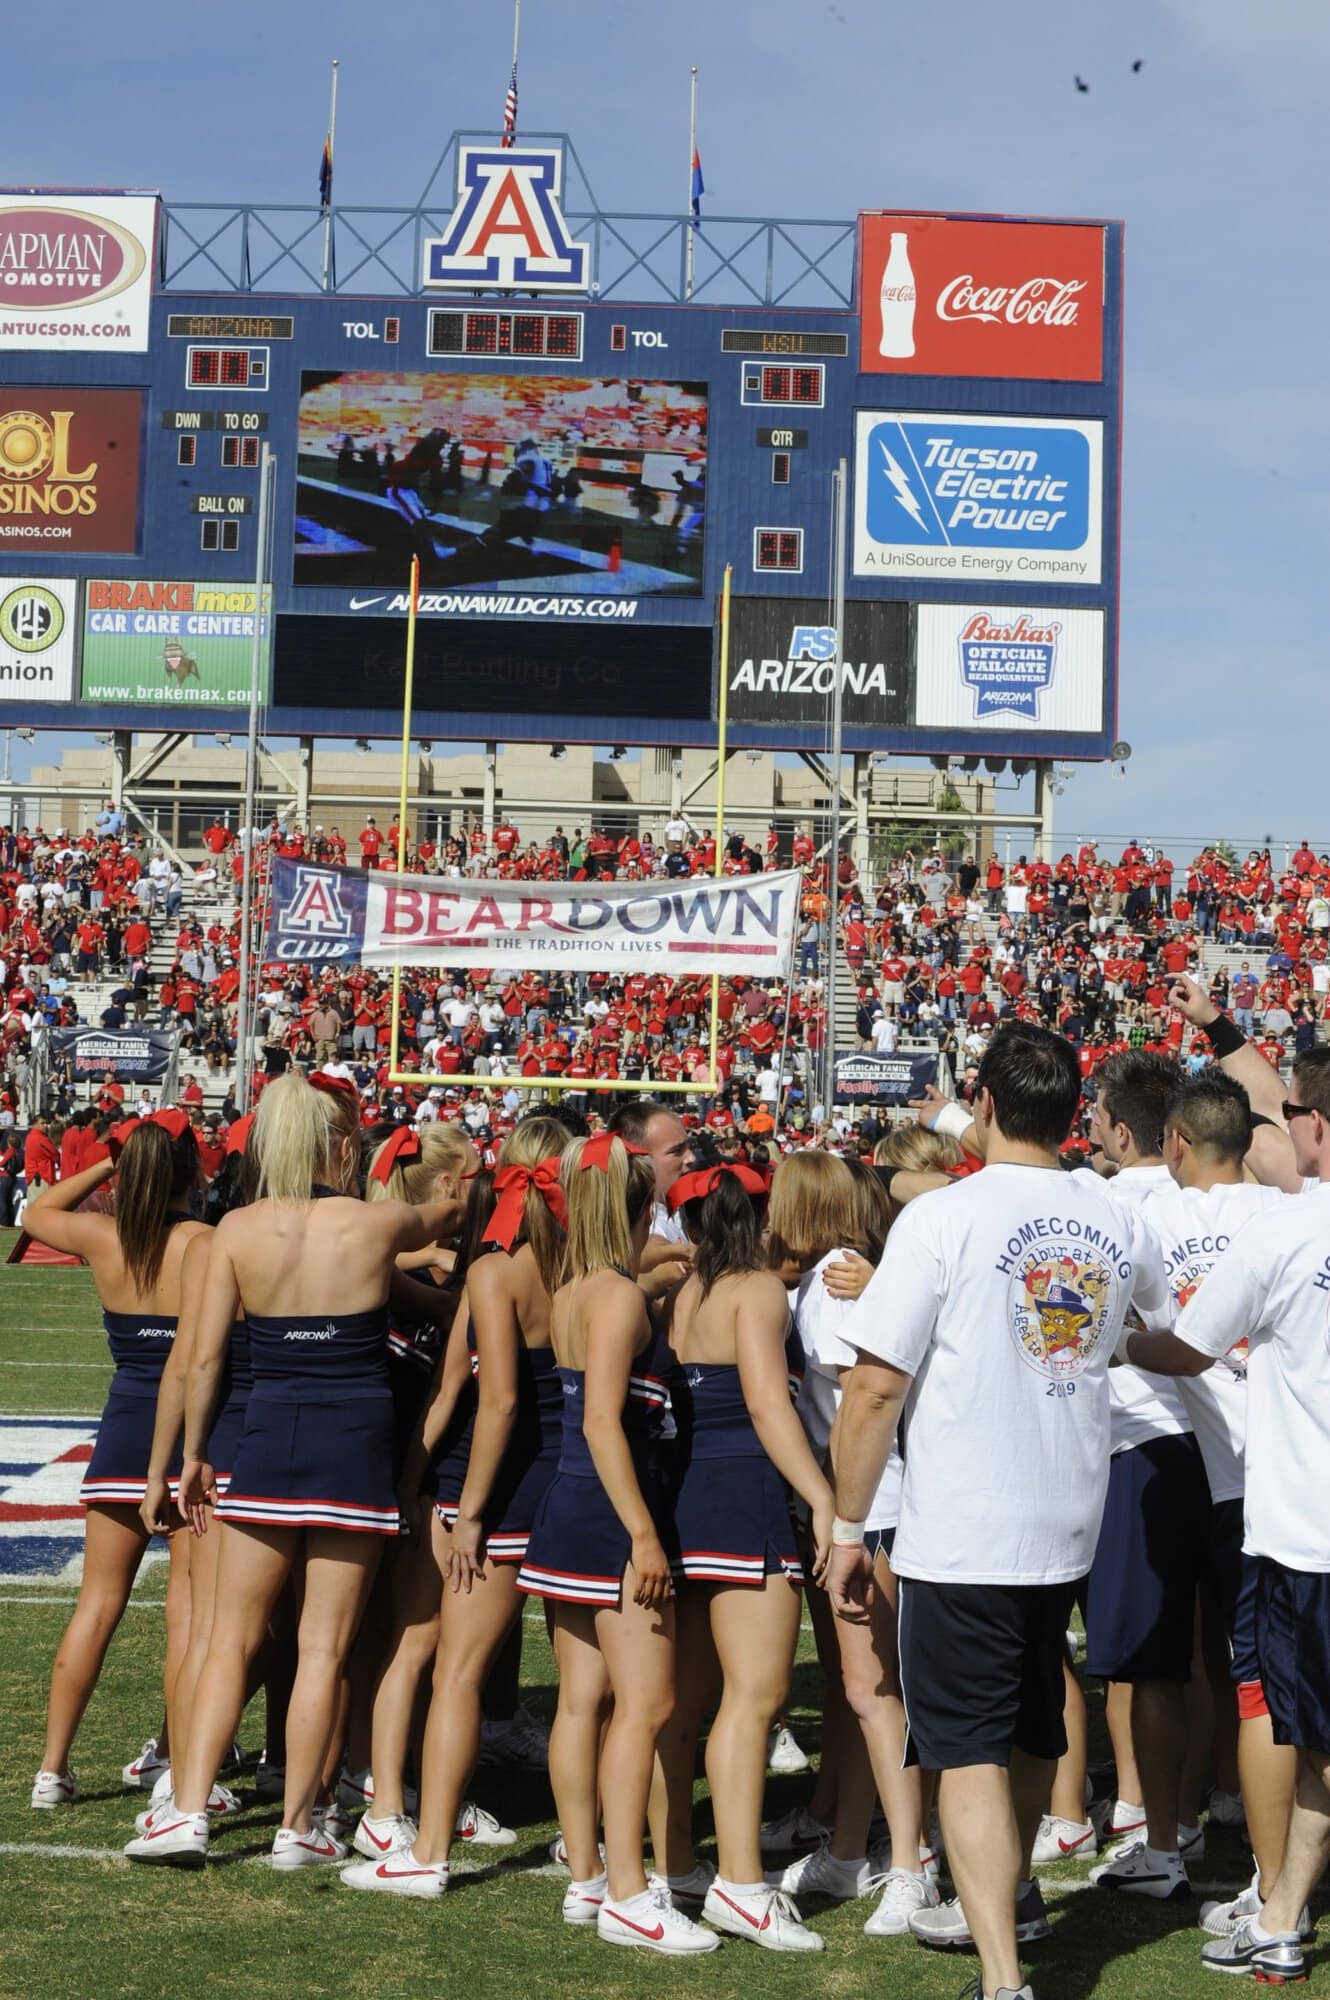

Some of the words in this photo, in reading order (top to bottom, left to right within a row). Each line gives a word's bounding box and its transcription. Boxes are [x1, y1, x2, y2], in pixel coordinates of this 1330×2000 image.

[0, 232, 107, 270] APMAN
[0, 271, 102, 288] OMOTIVE
[936, 274, 1088, 326] Coca-Cola
[0, 322, 131, 338] NTUCSON.COM
[189, 316, 272, 337] ARIZONA
[342, 322, 380, 338] TOL
[631, 331, 668, 347] TOL
[175, 413, 200, 428] DWN
[225, 413, 239, 429] TO
[242, 414, 259, 429] GO
[771, 430, 793, 446] QTR
[924, 438, 1038, 471] Tucson
[935, 469, 1068, 502] Electric
[198, 497, 224, 513] BALL
[228, 497, 244, 513] ON
[948, 500, 1067, 531] Power
[865, 552, 876, 564] A
[881, 552, 957, 568] UniSource
[961, 554, 1013, 573] Energy
[1017, 556, 1088, 575] Company
[88, 581, 195, 612] BRAKE
[91, 614, 127, 632] CAR
[133, 616, 180, 634] CARE
[962, 615, 1058, 643] Bashas'
[788, 625, 837, 661] FS
[364, 649, 428, 678] Kail
[968, 647, 1047, 660] OFFICIAL
[0, 660, 53, 681] nion
[968, 660, 1047, 673] TAILGATE
[729, 659, 887, 695] ARIZONA
[981, 691, 1033, 702] ARIZONA
[381, 887, 585, 936] BEAR
[568, 889, 783, 937] DOWN
[495, 938, 522, 949] THE
[529, 939, 614, 952] TRADITION
[621, 941, 663, 952] LIVES
[78, 1041, 118, 1049] AMERICAN
[120, 1041, 149, 1049] FAMILY
[839, 1064, 880, 1072] AMERICAN
[883, 1065, 911, 1073] FAMILY
[995, 1217, 1132, 1280] HOMECOMING
[1015, 1246, 1067, 1283] Wilbur
[1072, 1248, 1093, 1265] at
[283, 1331, 330, 1341] ARIZONA
